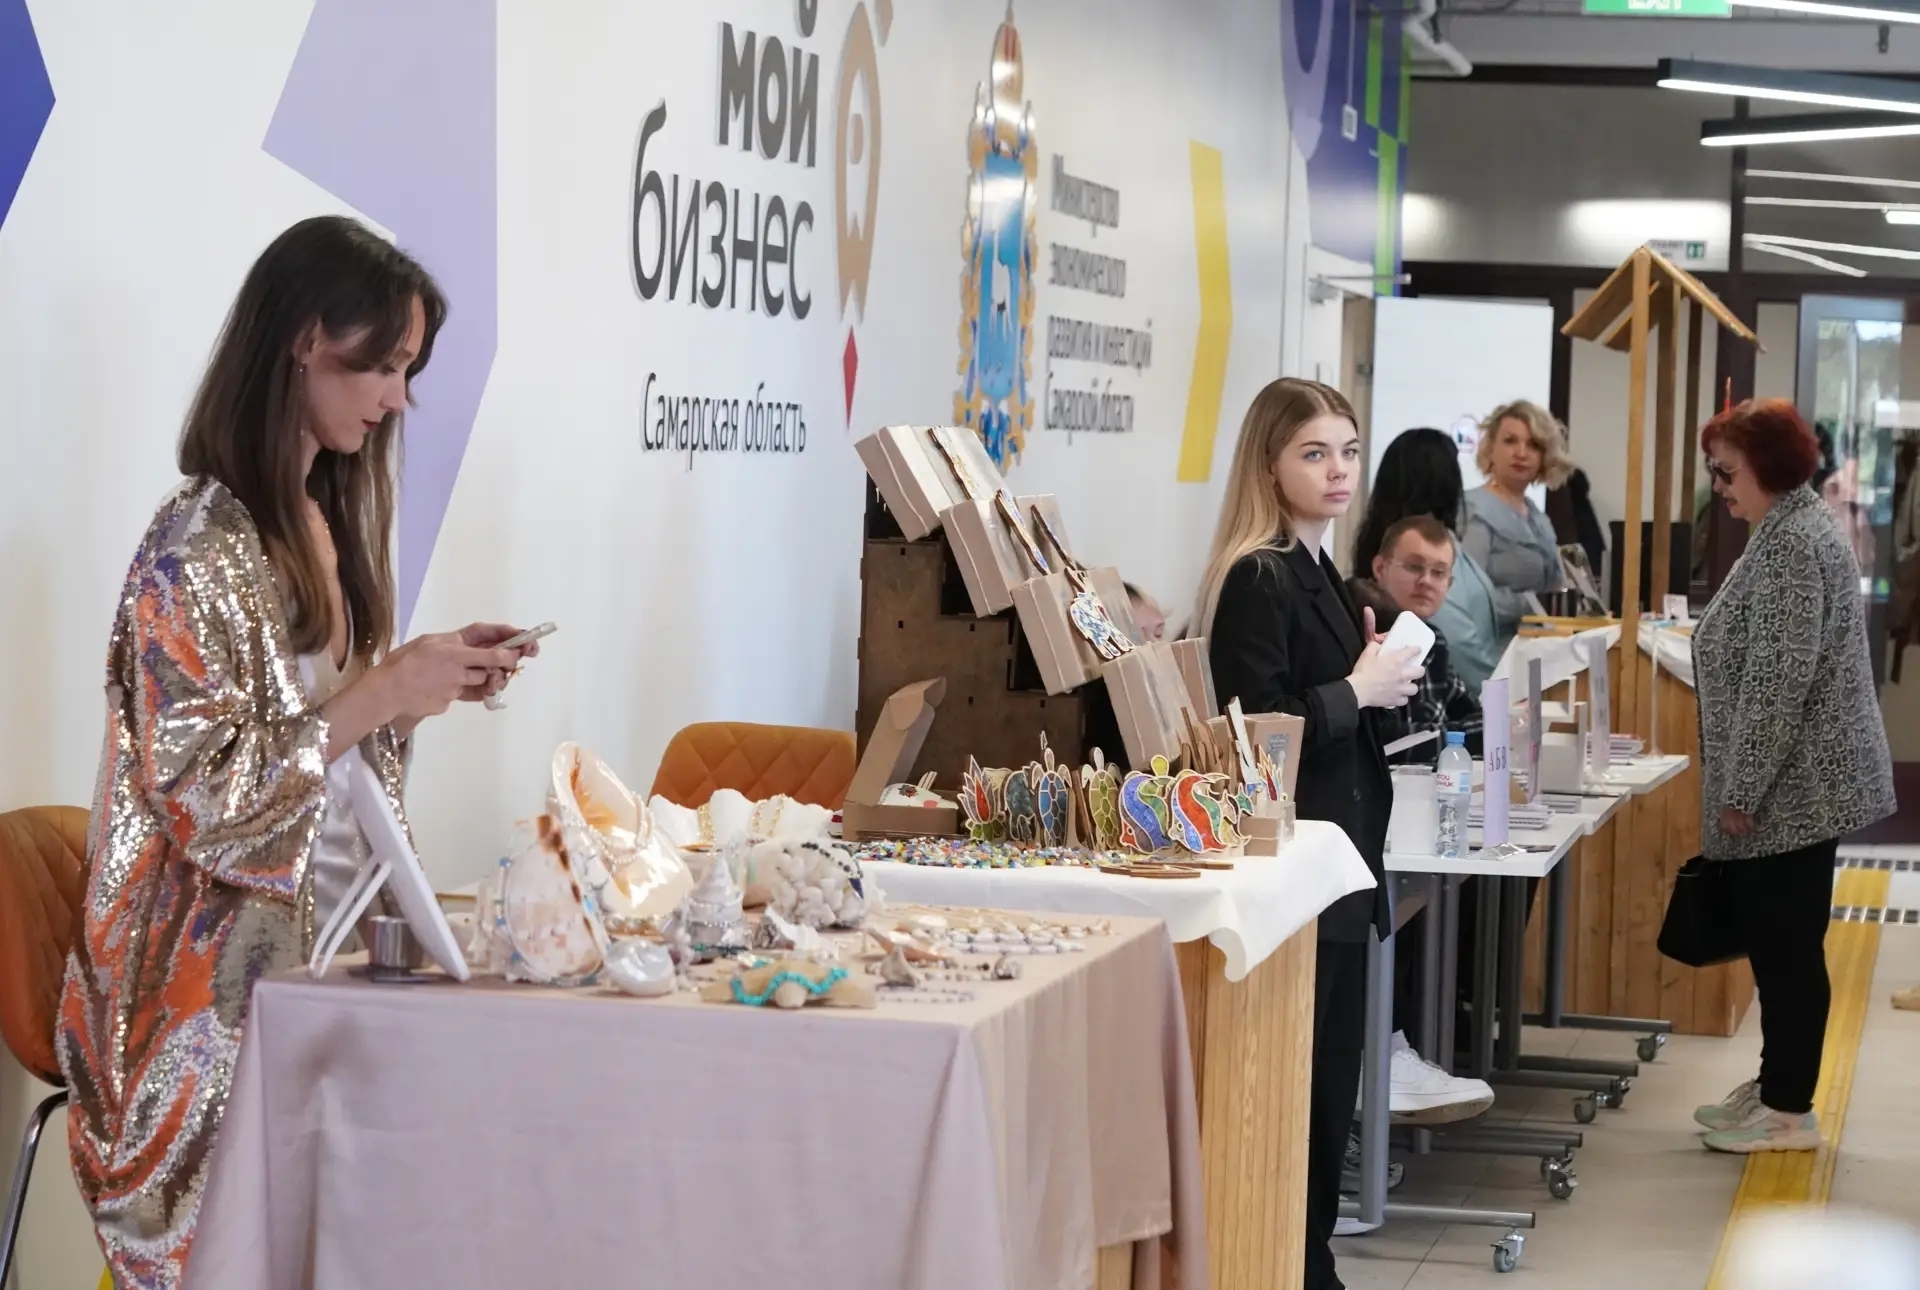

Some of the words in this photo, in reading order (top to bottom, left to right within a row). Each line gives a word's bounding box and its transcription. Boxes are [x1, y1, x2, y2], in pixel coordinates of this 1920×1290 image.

[631, 98, 815, 321] бизнес
[643, 372, 739, 471] Самарская
[744, 381, 807, 453] область
